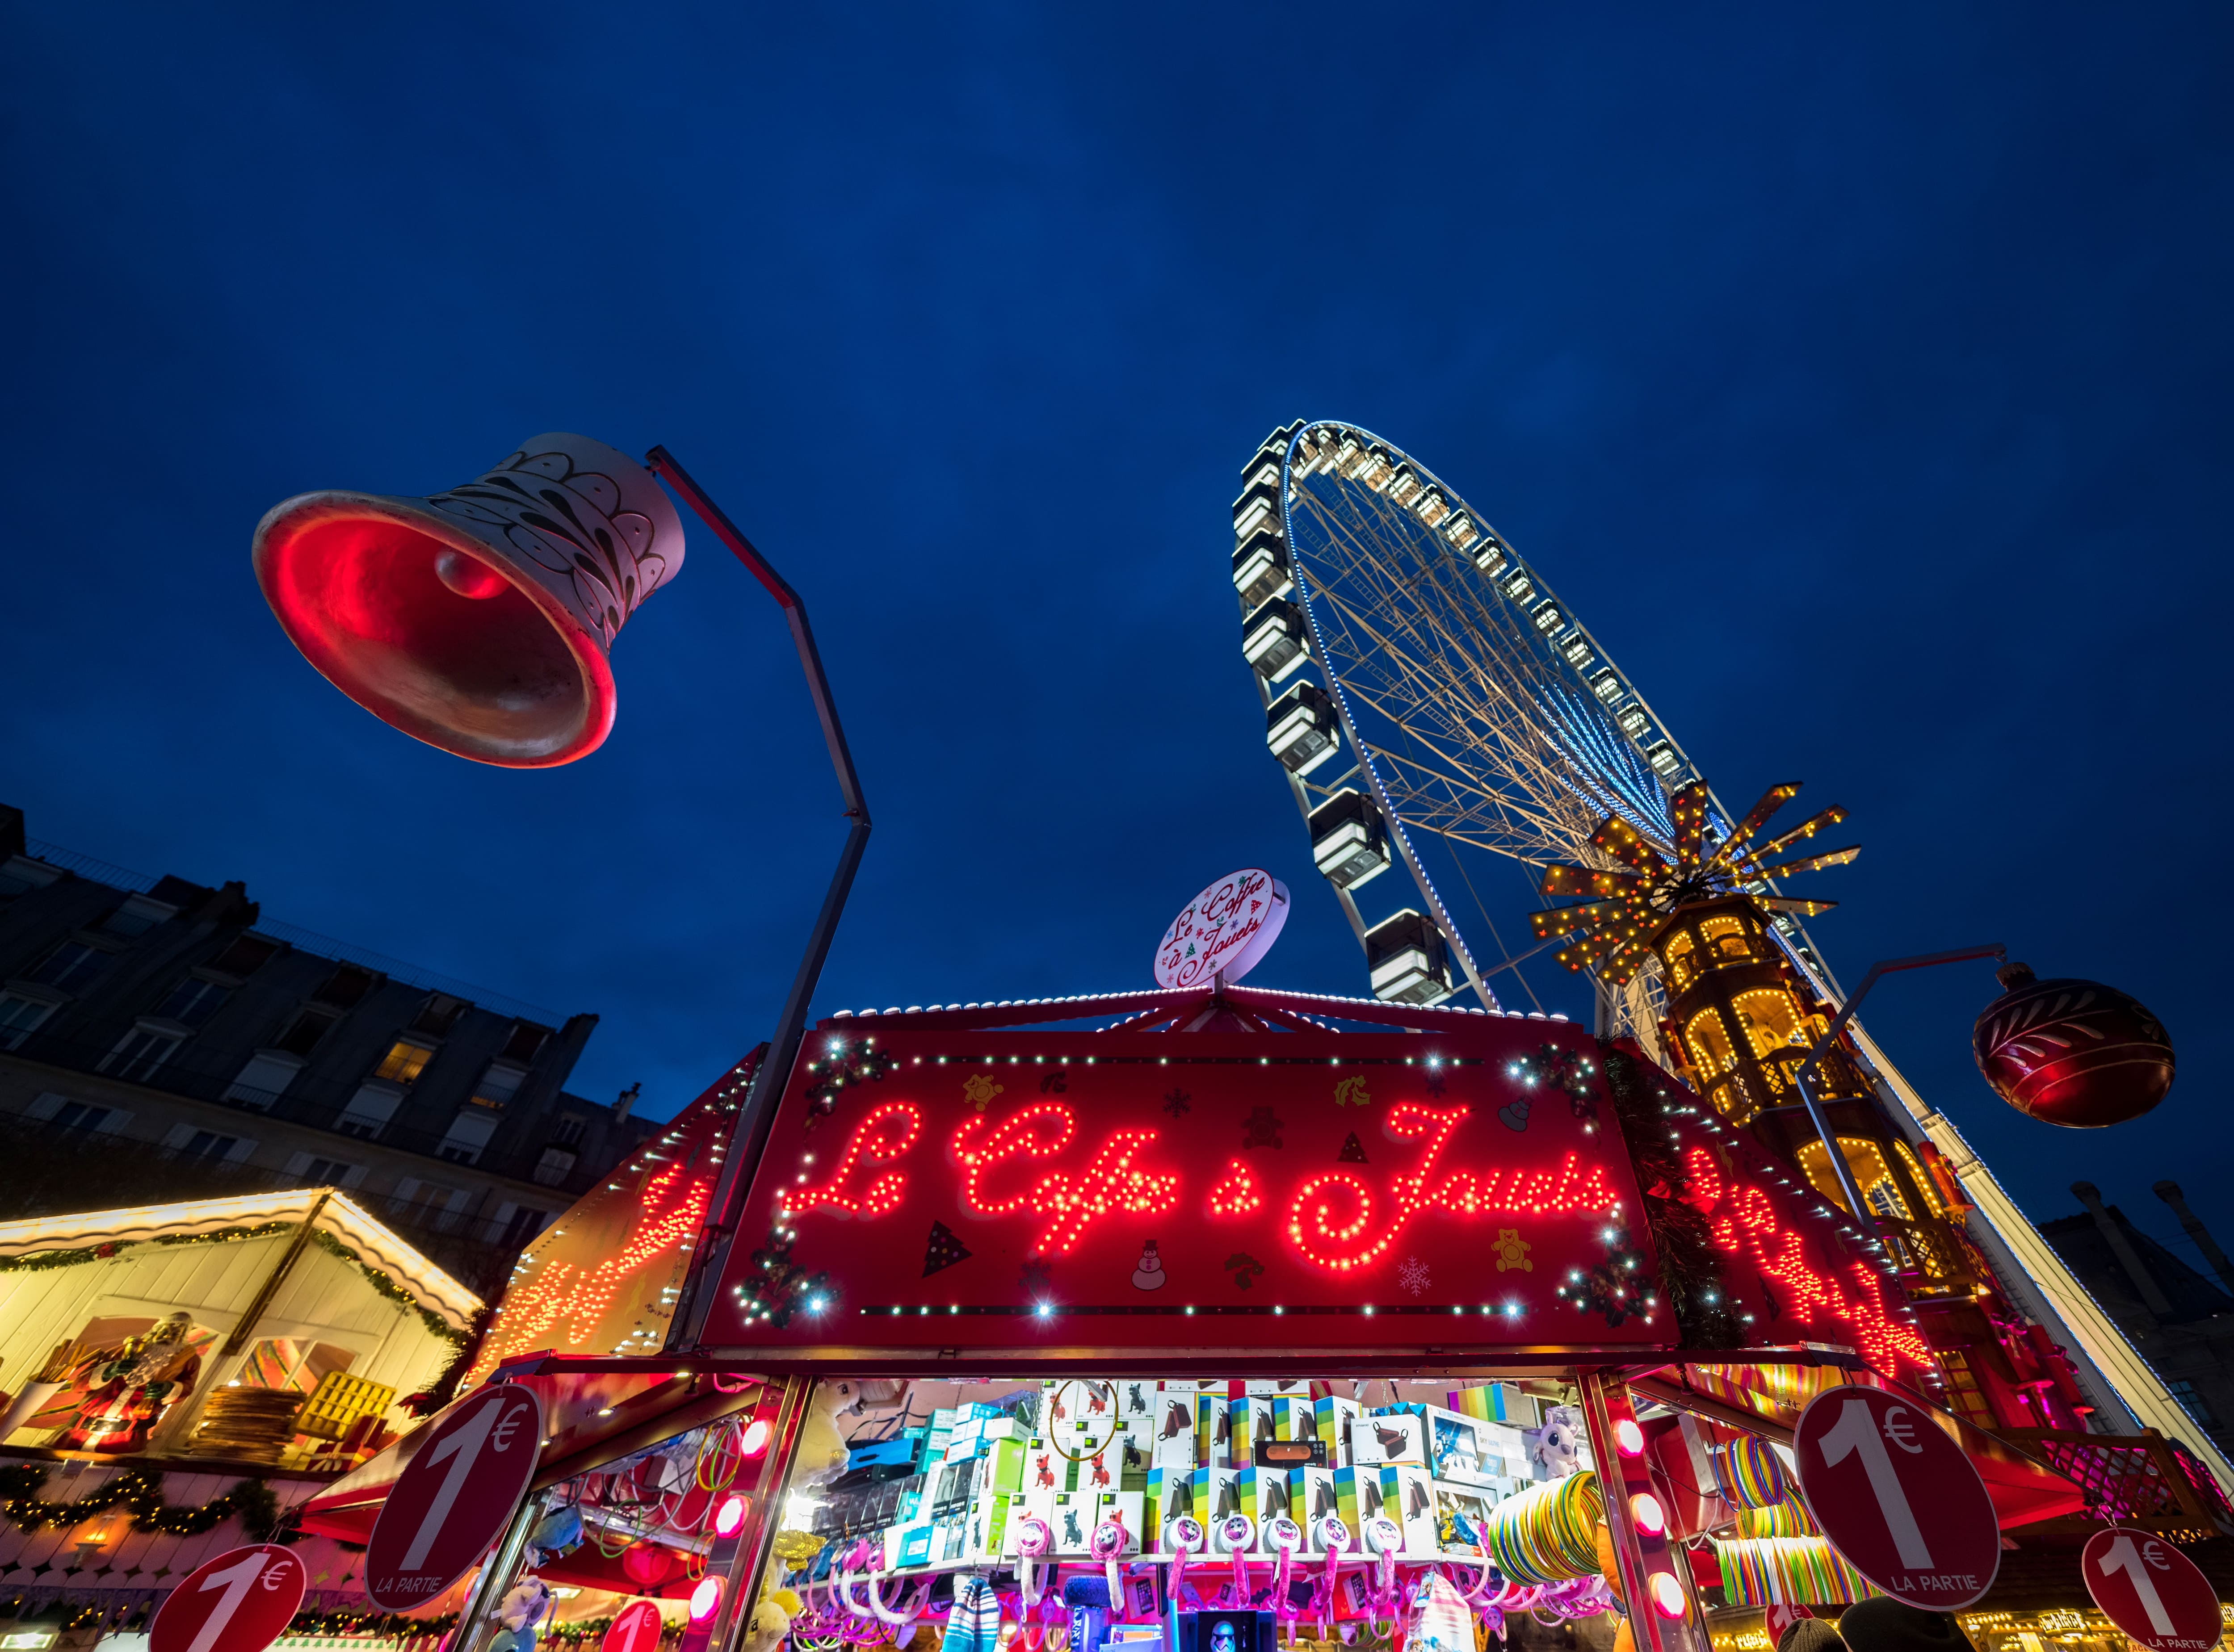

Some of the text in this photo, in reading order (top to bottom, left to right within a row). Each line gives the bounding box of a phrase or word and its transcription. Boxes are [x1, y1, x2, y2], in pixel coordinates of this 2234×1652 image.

[1163, 872, 1265, 951] Le Coffre
[1168, 918, 1260, 987] à Jouets
[781, 1102, 923, 1214] Le
[953, 1103, 1179, 1254] Coffre
[1289, 1103, 1619, 1271] Jouets
[375, 1577, 442, 1593] LA PARTIE
[1891, 1574, 1980, 1591] LA PARTIE
[2148, 1638, 2165, 1648] LA
[2167, 1639, 2209, 1649] PARTIE
